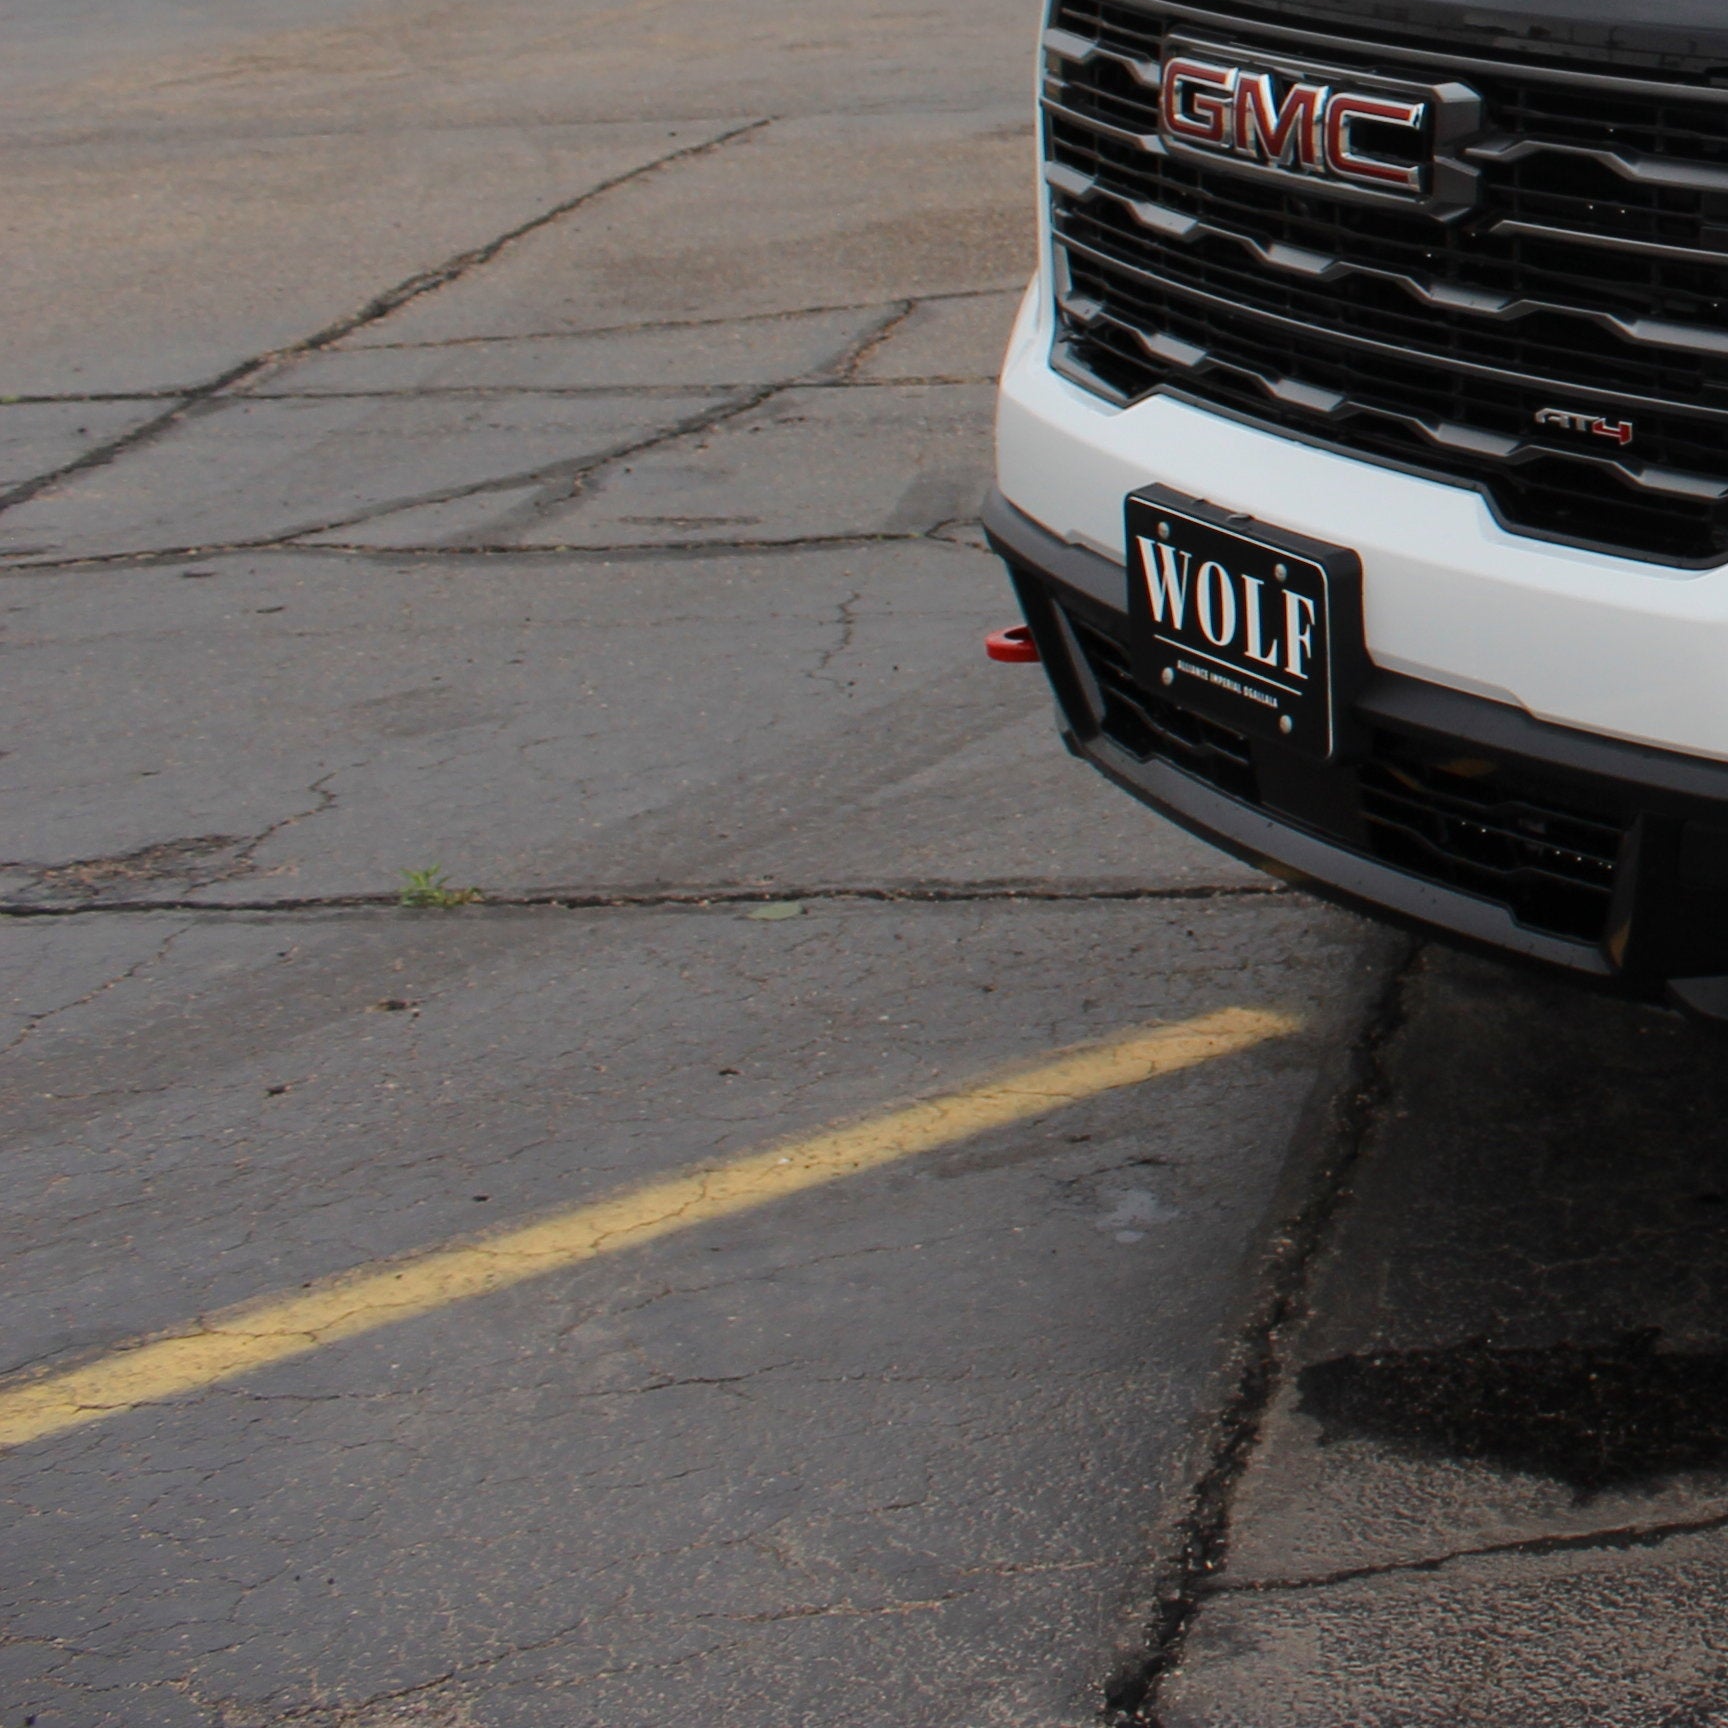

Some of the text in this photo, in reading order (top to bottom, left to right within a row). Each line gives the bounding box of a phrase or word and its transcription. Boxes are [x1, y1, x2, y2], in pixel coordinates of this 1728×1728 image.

[1162, 57, 1424, 192] GMC
[1535, 408, 1632, 445] AT4
[1136, 535, 1315, 679] WOLF
[1177, 659, 1209, 681] ALLIANCE
[1209, 672, 1242, 694] IMPERIAL
